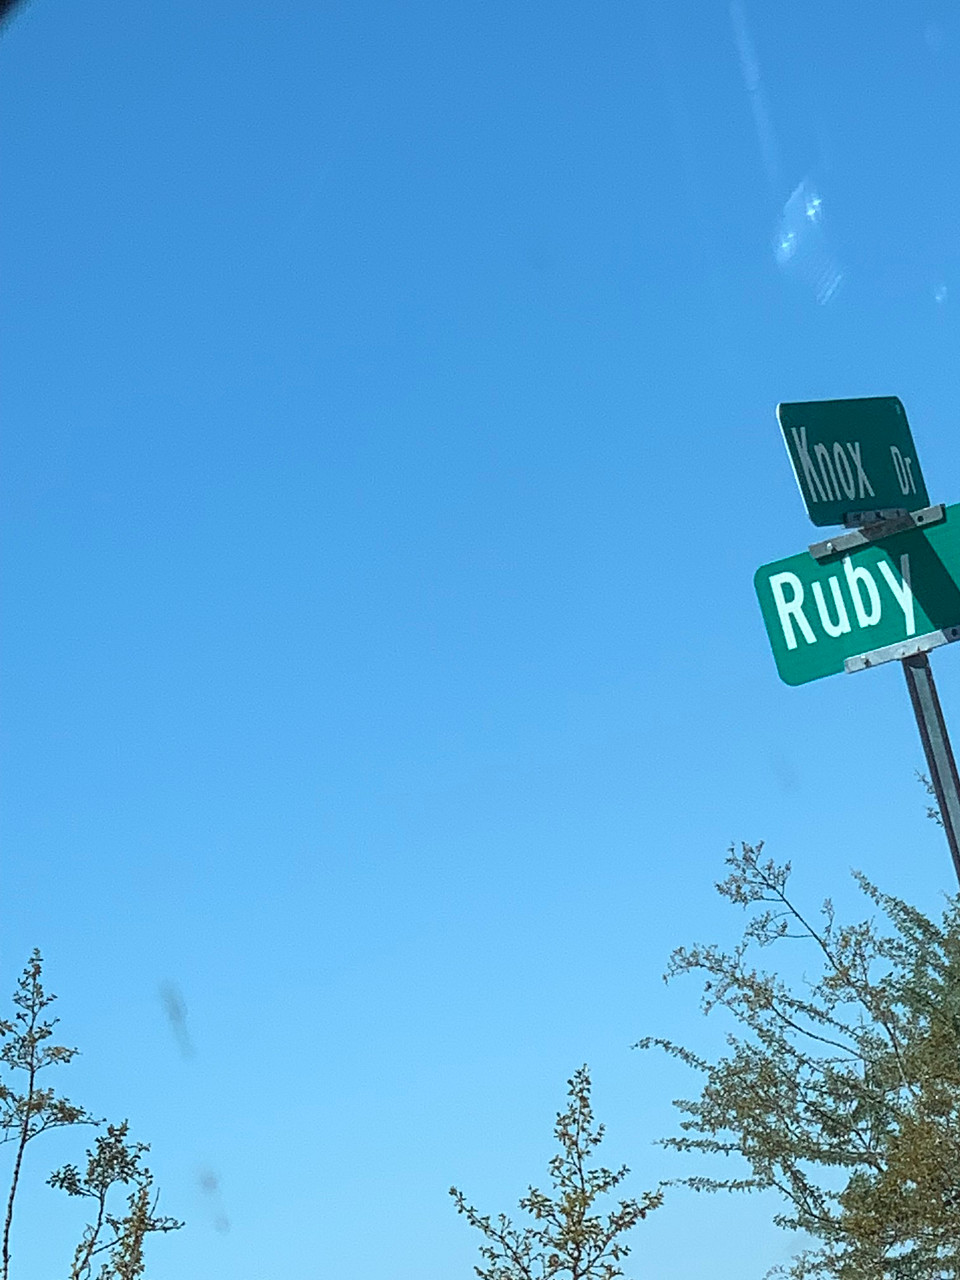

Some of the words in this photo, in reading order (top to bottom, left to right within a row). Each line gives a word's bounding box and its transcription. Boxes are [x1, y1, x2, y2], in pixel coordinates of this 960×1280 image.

[791, 426, 875, 502] Knox
[890, 445, 917, 495] Dr
[768, 553, 916, 651] Ruby
